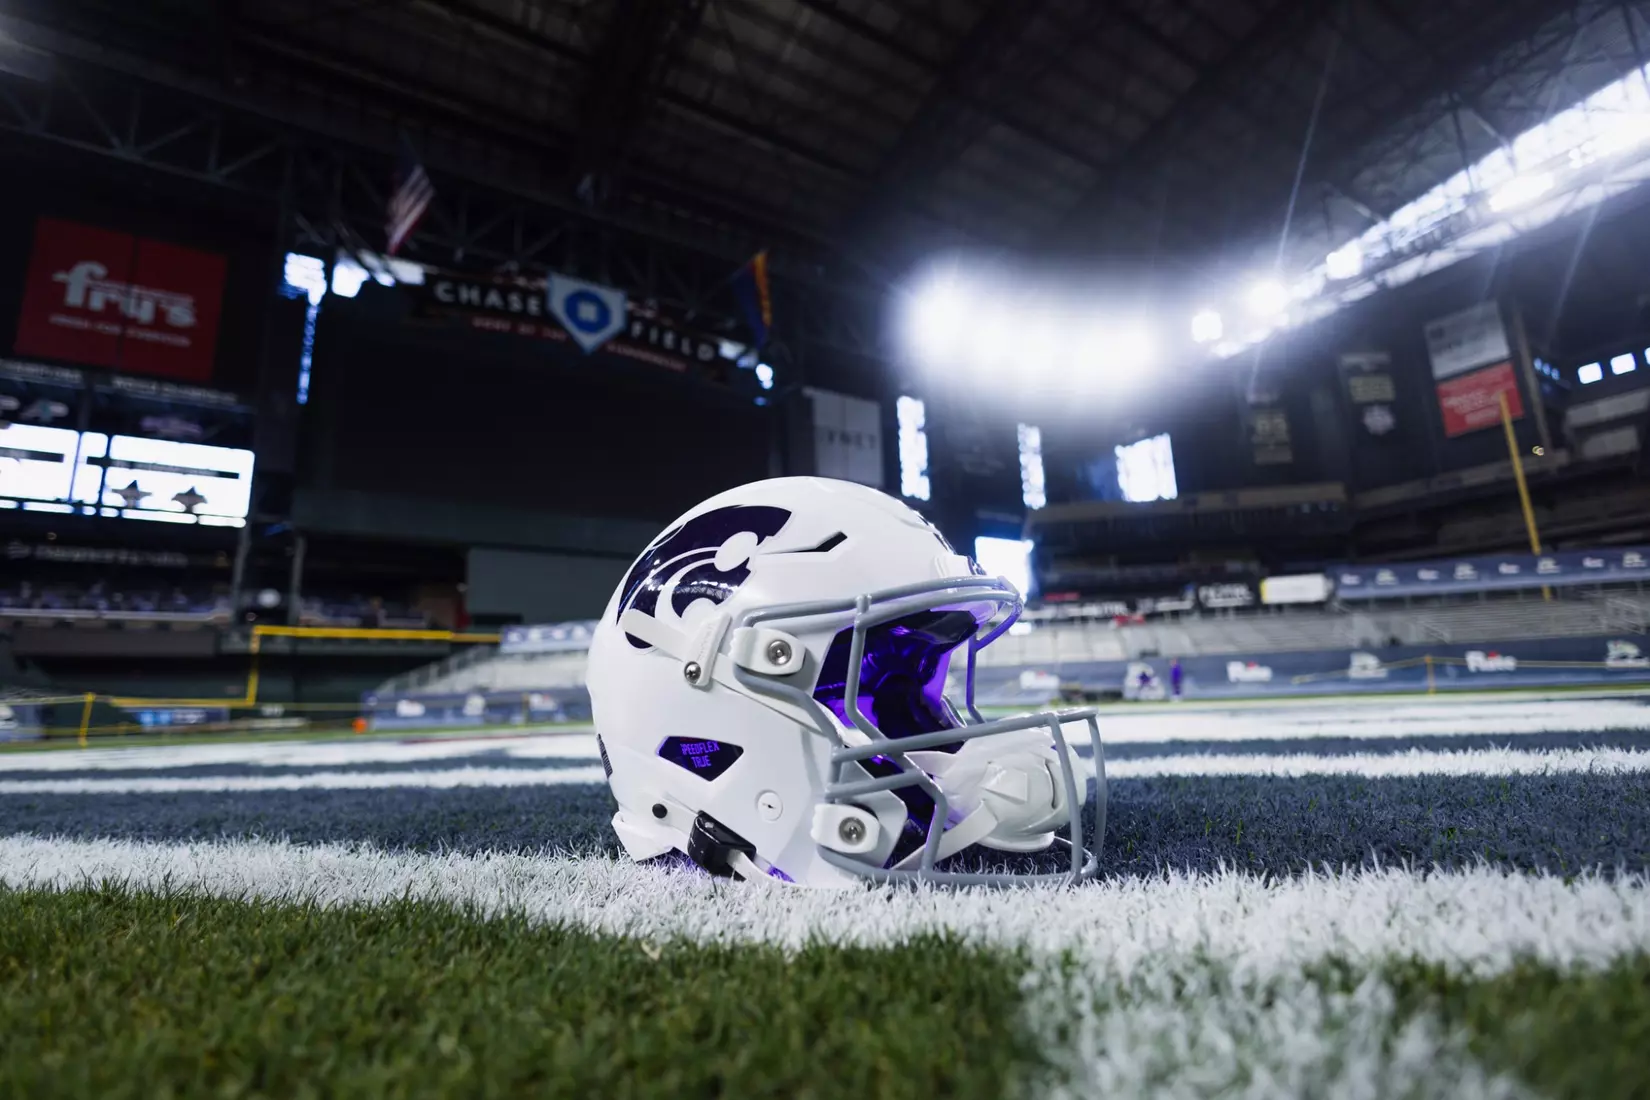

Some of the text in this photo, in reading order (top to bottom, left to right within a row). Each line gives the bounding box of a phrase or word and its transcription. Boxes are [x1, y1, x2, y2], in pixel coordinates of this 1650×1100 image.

[433, 281, 542, 317] CHASE
[631, 320, 715, 361] FIELD
[691, 755, 711, 768] TRUE
